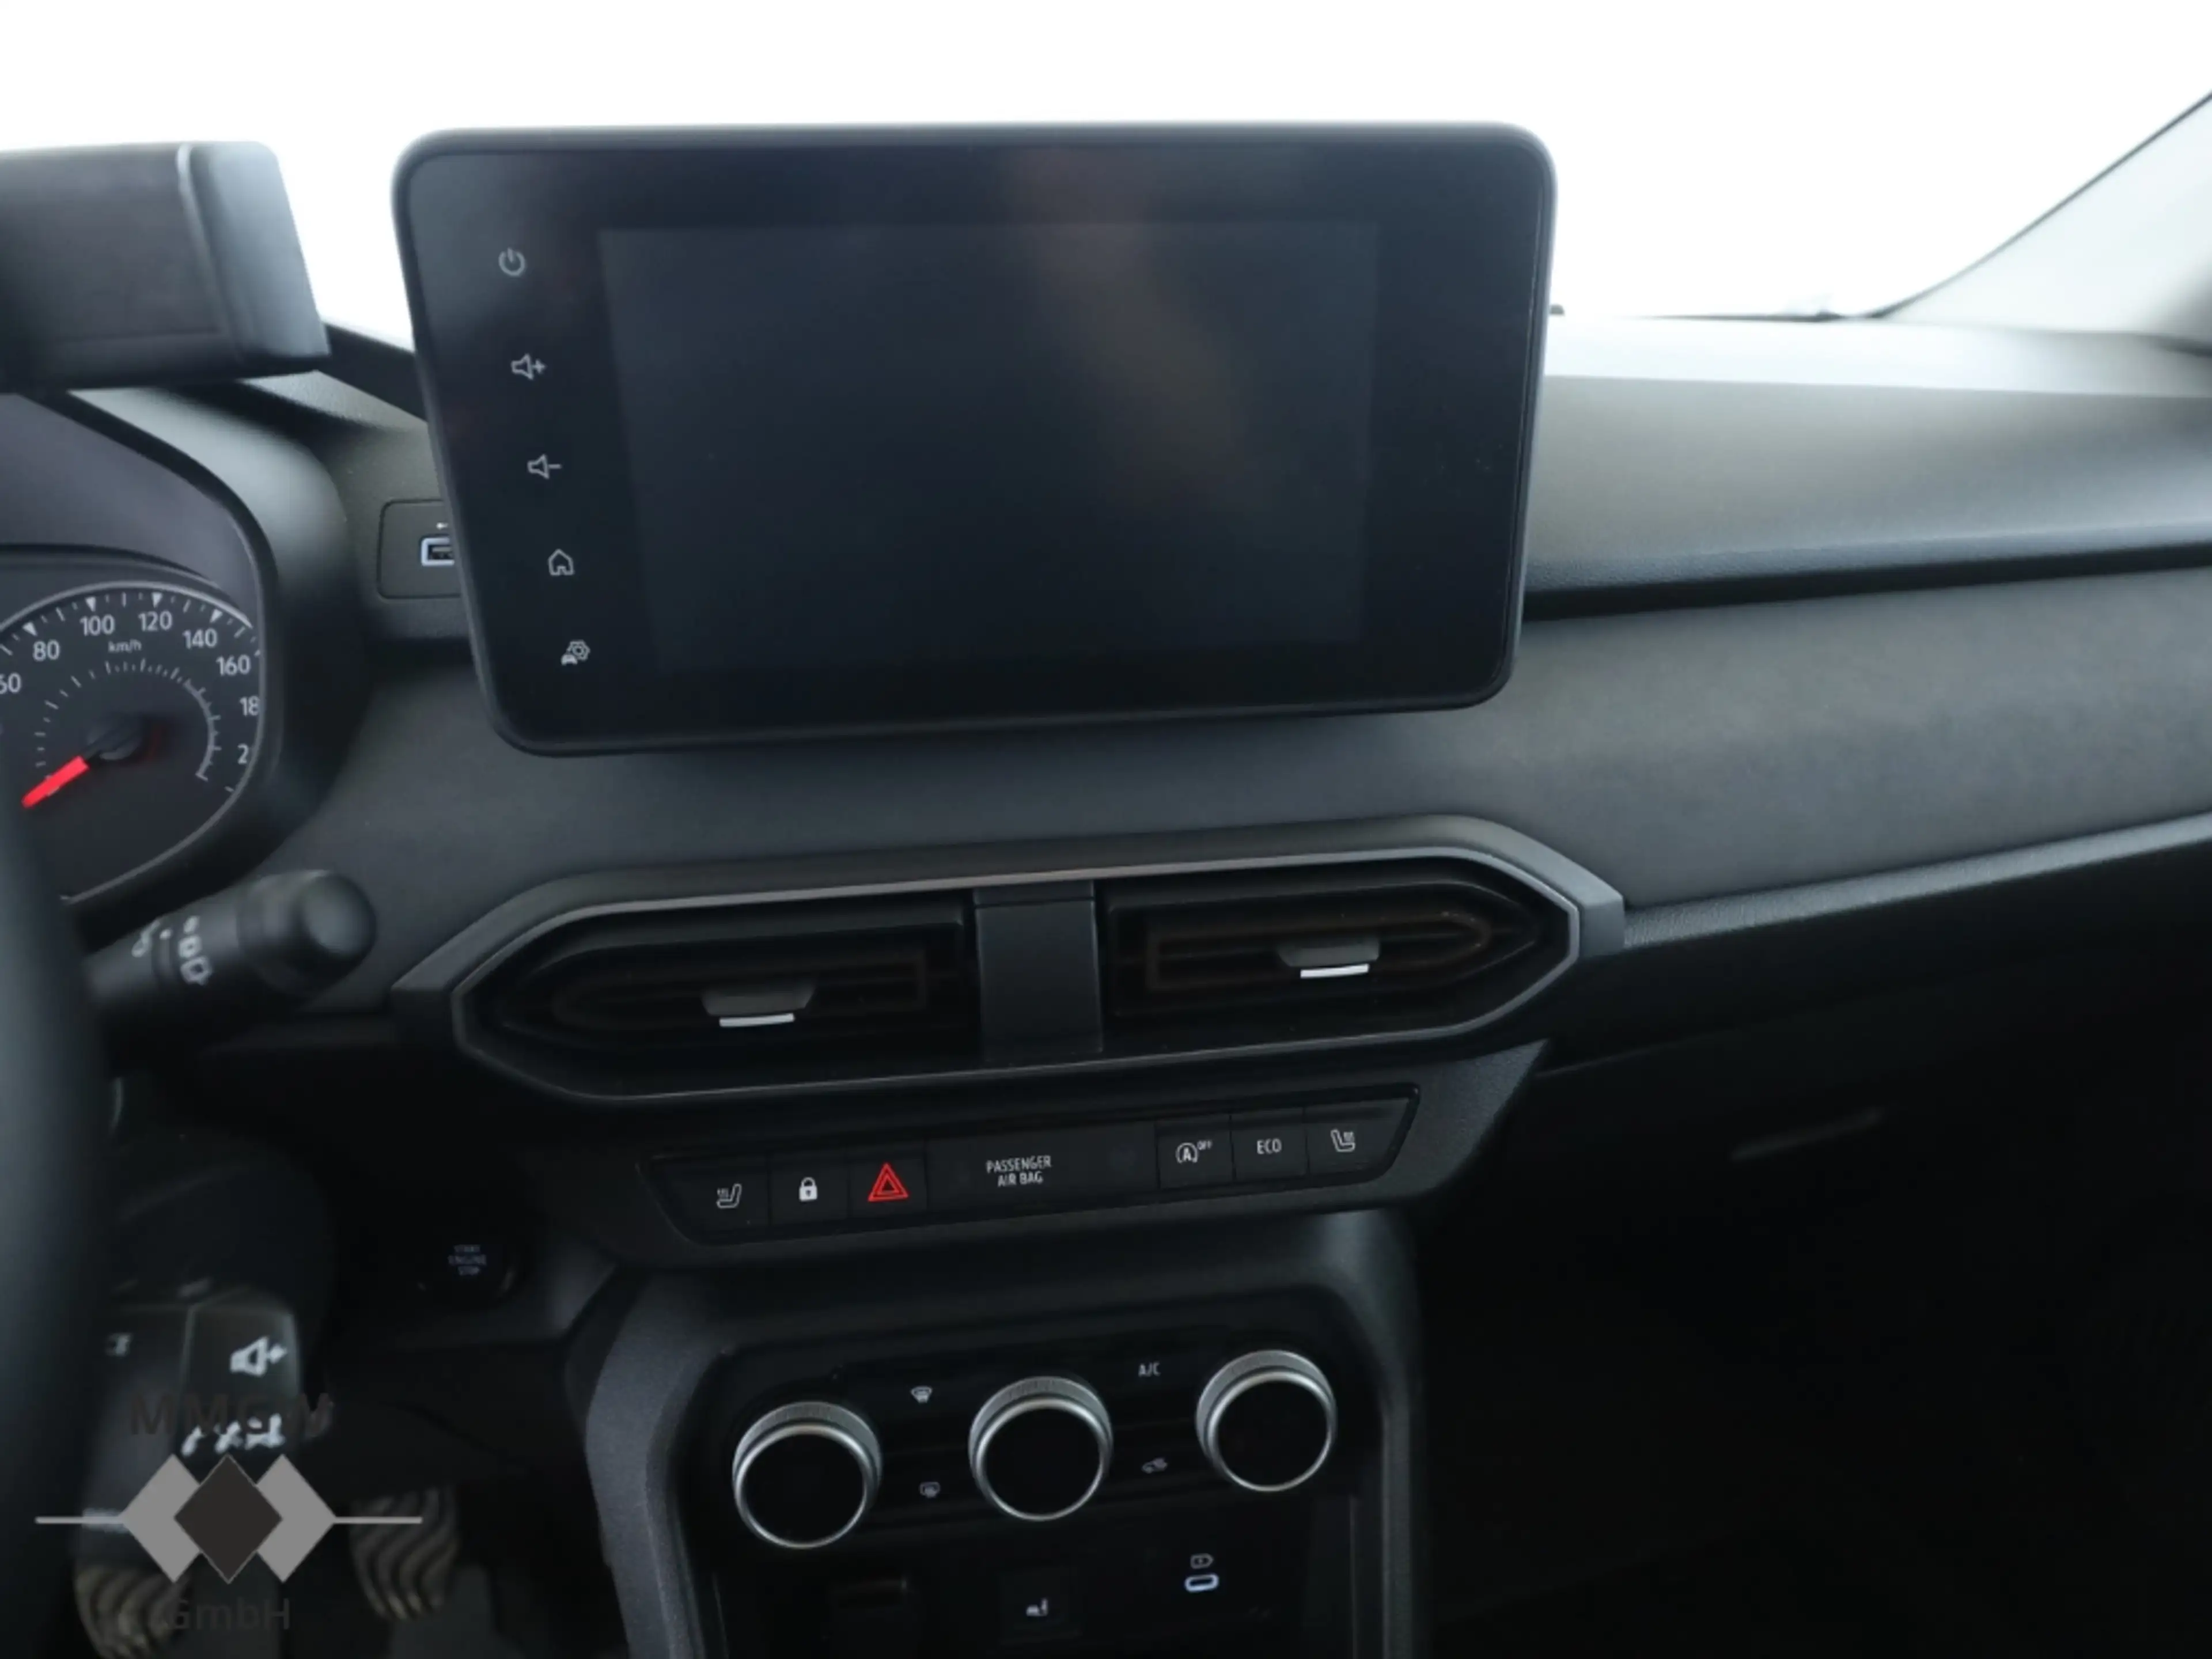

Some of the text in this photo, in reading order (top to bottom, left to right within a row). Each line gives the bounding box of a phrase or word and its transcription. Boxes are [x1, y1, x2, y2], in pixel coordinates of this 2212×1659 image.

[79, 614, 115, 636] 100
[138, 611, 172, 631] 120
[108, 639, 142, 653] km/h
[183, 628, 218, 649] 140
[32, 639, 60, 661] 80
[216, 654, 251, 676] 160
[1257, 1138, 1282, 1154] ECO
[986, 1154, 1051, 1173] PASSENGER
[998, 1171, 1044, 1187] AIR BAG
[1138, 1362, 1161, 1377] A/C
